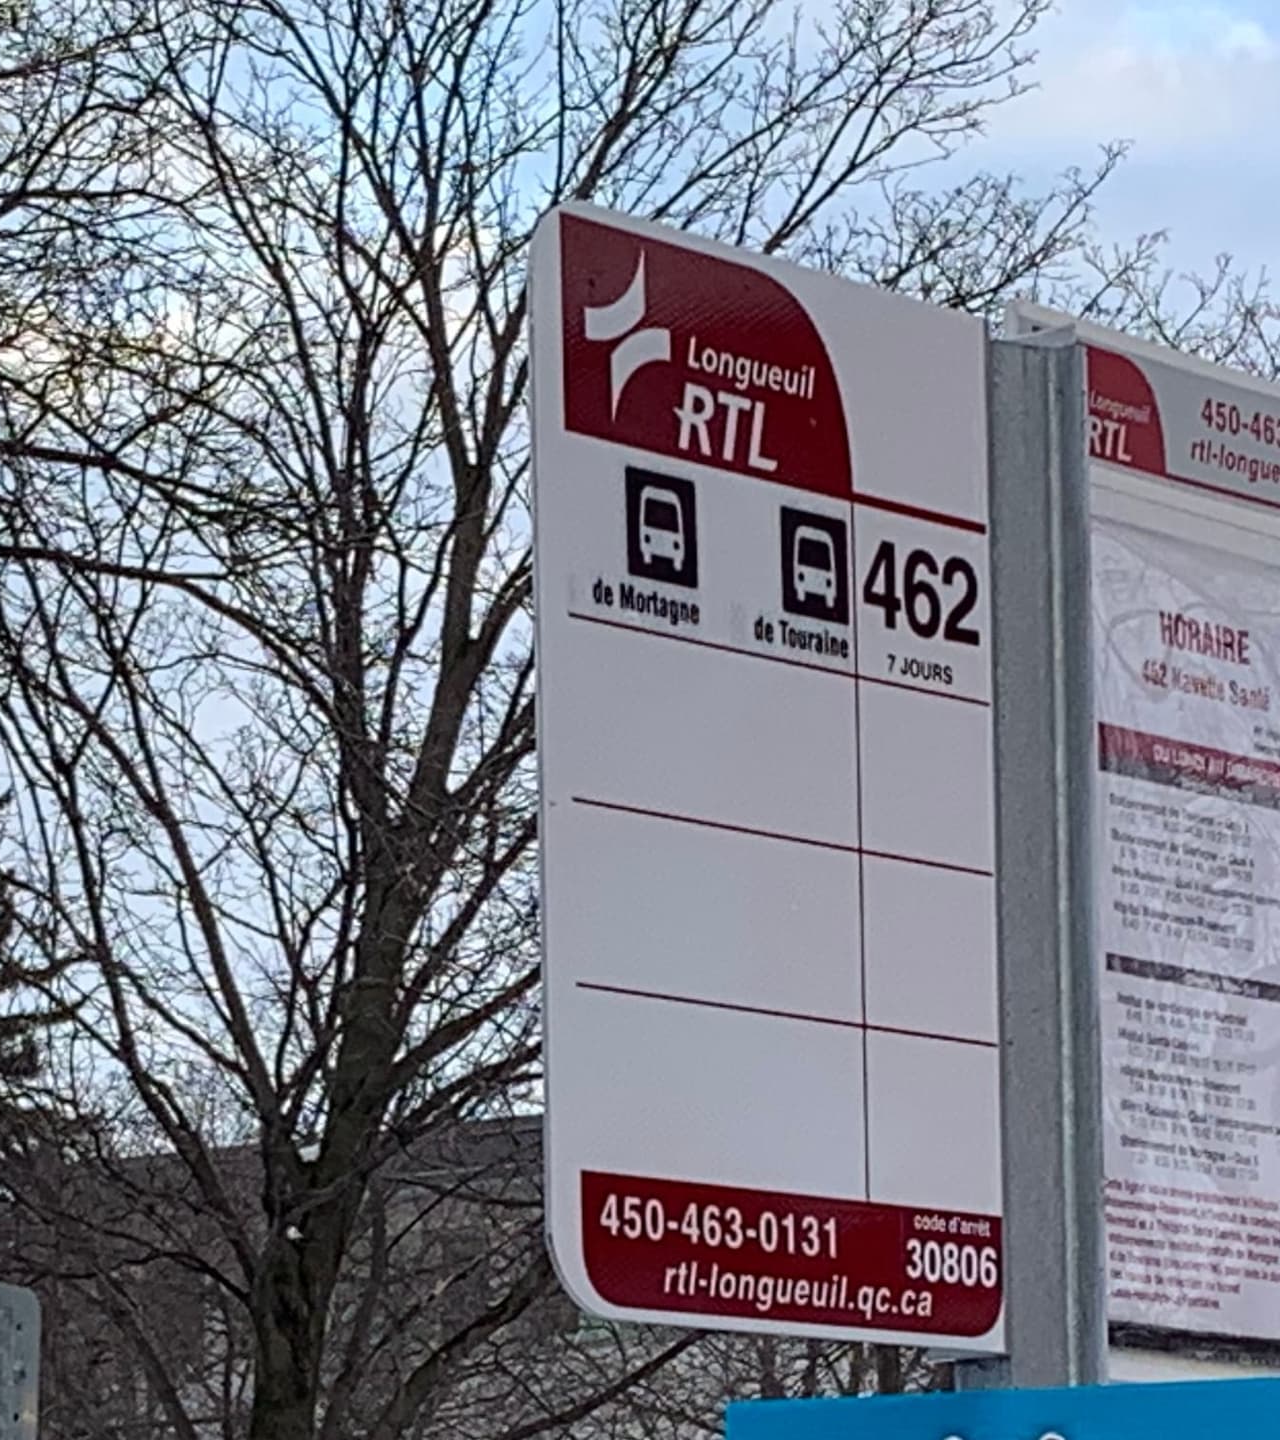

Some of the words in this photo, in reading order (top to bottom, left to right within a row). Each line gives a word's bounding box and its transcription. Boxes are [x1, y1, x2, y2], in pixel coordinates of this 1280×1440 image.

[687, 335, 816, 400] Longueuil
[676, 381, 778, 472] RTL
[1086, 415, 1132, 462] RTL
[592, 578, 614, 607] de
[619, 582, 701, 626] Mortagne
[863, 539, 981, 647] 462
[753, 615, 775, 644] de
[779, 618, 850, 659] Touraine
[1159, 610, 1251, 666] HORAIRE
[886, 653, 897, 673] 7
[900, 656, 954, 686] JOURS
[600, 1193, 839, 1259] 450-463-0131
[913, 1213, 947, 1233] code
[663, 1259, 933, 1320] rtl-longueuil.qc.ca
[905, 1238, 998, 1288] 30806
